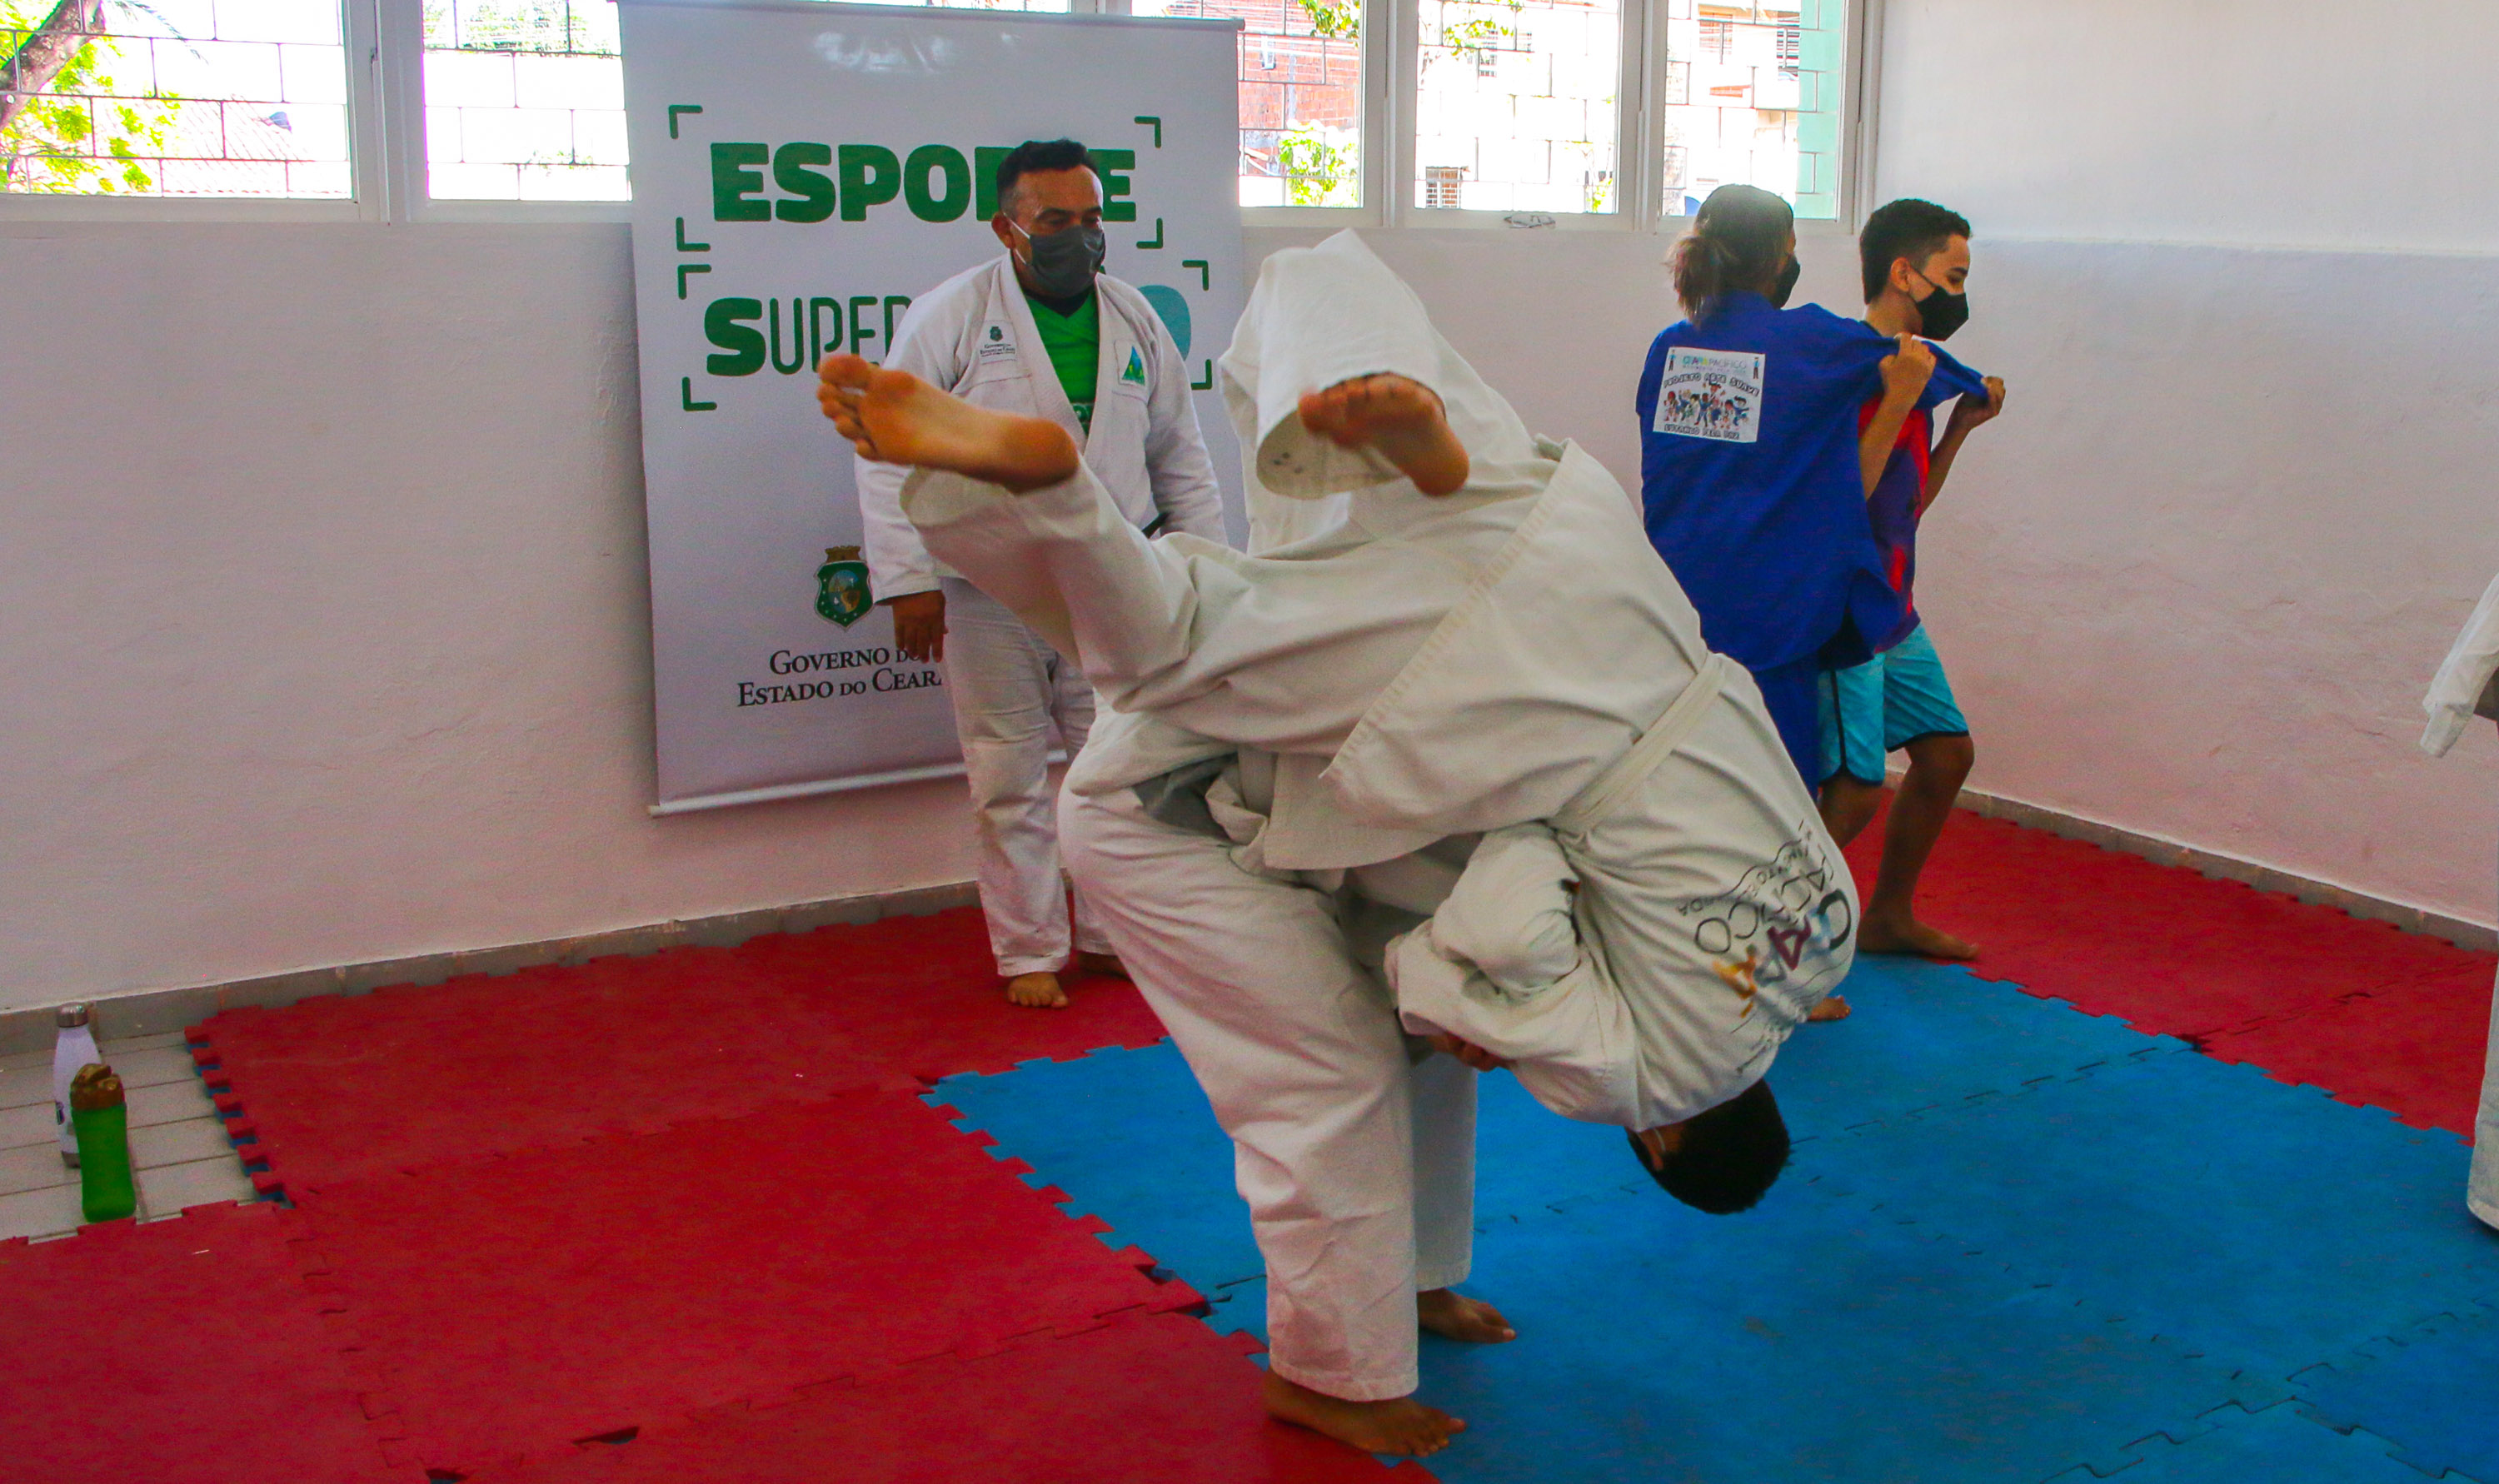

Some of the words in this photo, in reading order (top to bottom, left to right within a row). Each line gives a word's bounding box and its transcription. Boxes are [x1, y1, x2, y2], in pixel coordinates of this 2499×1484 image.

[710, 142, 1137, 224] ESPOE
[769, 647, 890, 675] GOVERNO
[895, 649, 920, 663] D
[736, 680, 834, 707] ESTADO
[839, 680, 867, 697] DO
[871, 667, 943, 693] CEAR
